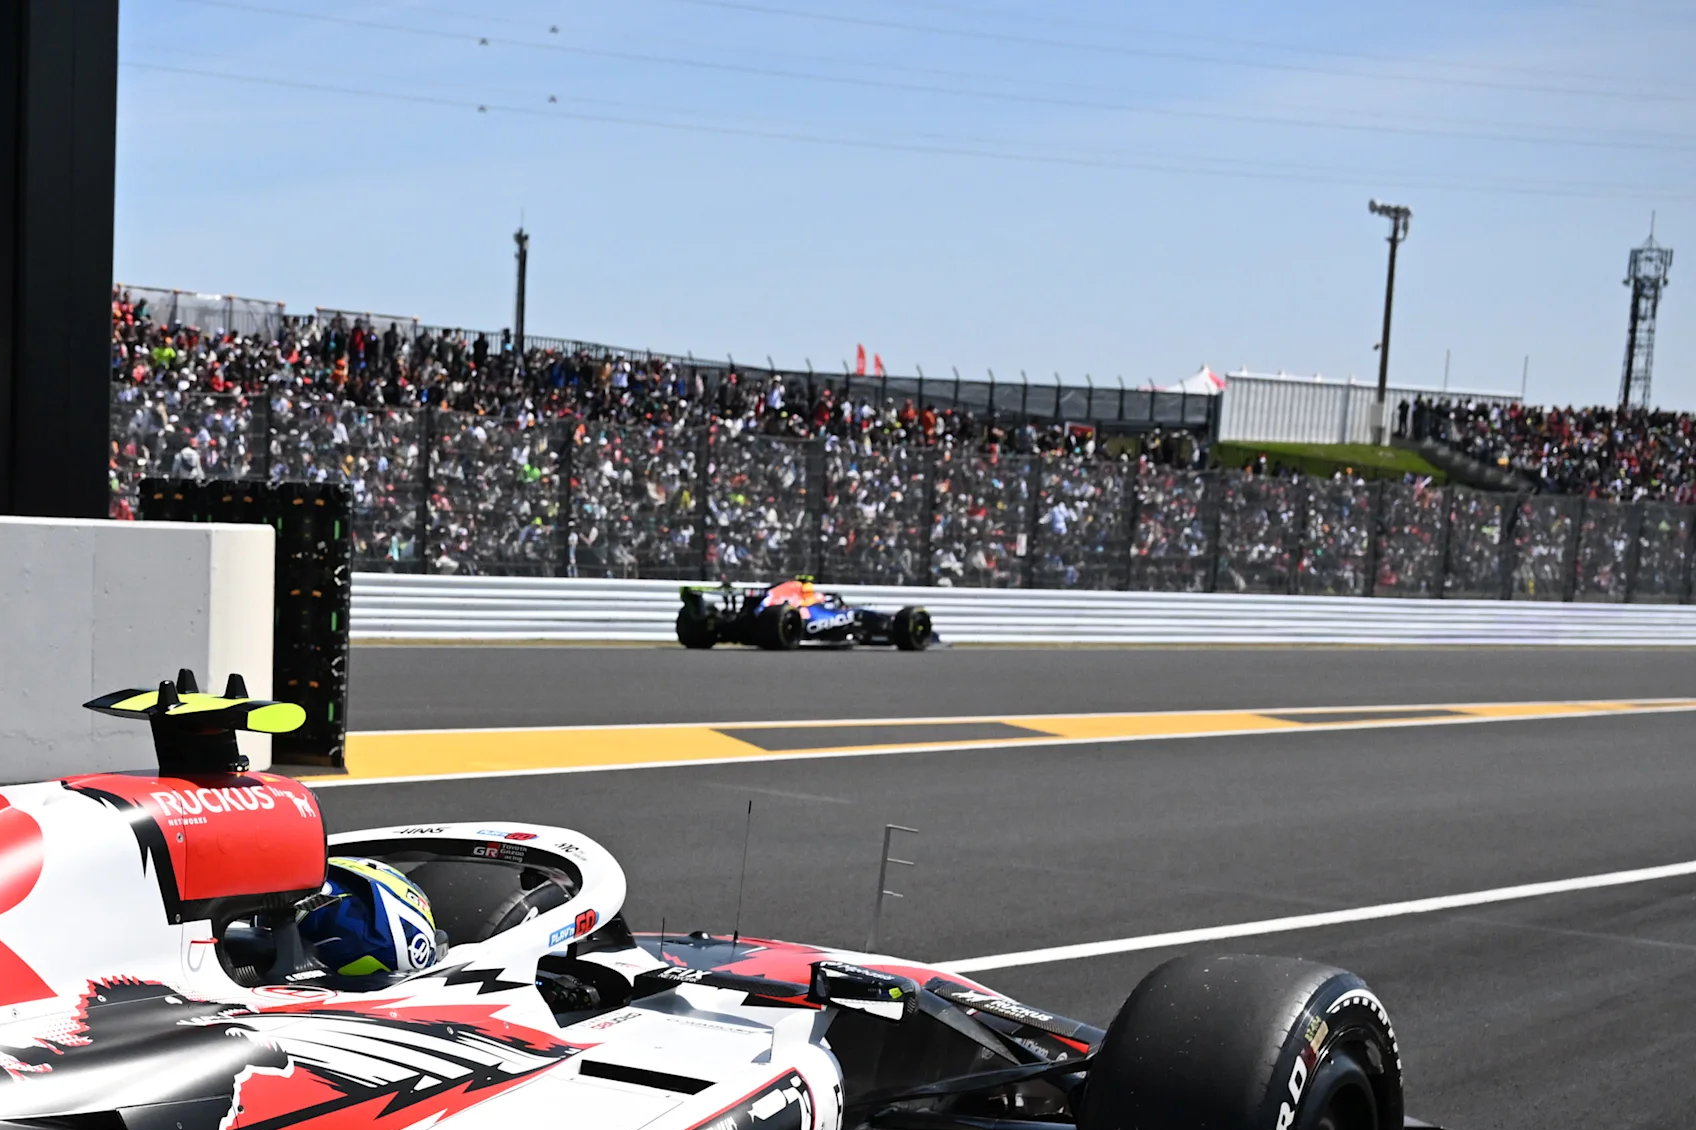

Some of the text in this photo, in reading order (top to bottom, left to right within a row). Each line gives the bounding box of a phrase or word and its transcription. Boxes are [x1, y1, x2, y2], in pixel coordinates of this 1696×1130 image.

[150, 785, 275, 816] RUCKUS
[168, 817, 207, 826] NETWORKS
[575, 909, 596, 938] GO
[664, 966, 712, 979] FIX
